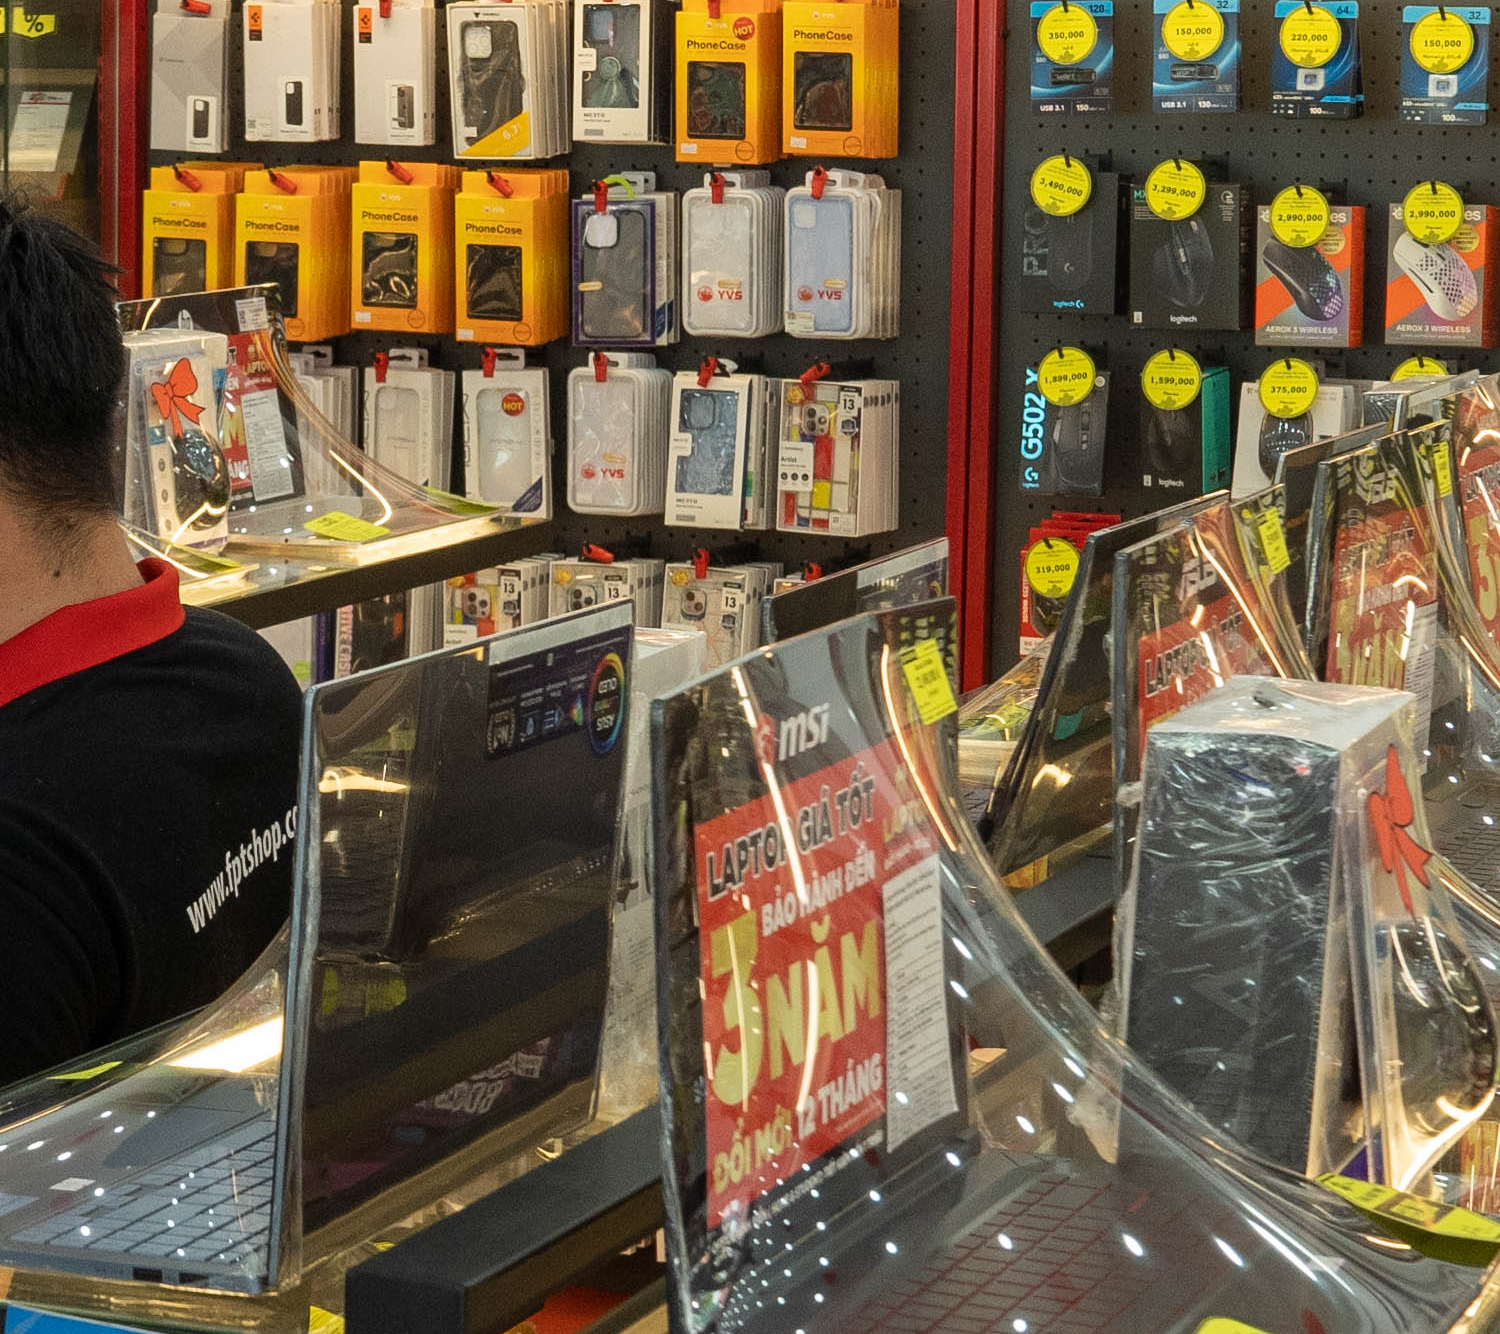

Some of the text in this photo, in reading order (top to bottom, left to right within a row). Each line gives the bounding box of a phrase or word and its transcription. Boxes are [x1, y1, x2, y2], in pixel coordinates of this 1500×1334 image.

[793, 30, 853, 43] PhoneCase
[1175, 27, 1213, 36] 150,000
[1039, 176, 1084, 198] 3,490,000
[1408, 209, 1456, 220] 2,990,000
[718, 288, 743, 301] YVS
[1270, 385, 1308, 395] 375,000
[777, 700, 830, 762] msi
